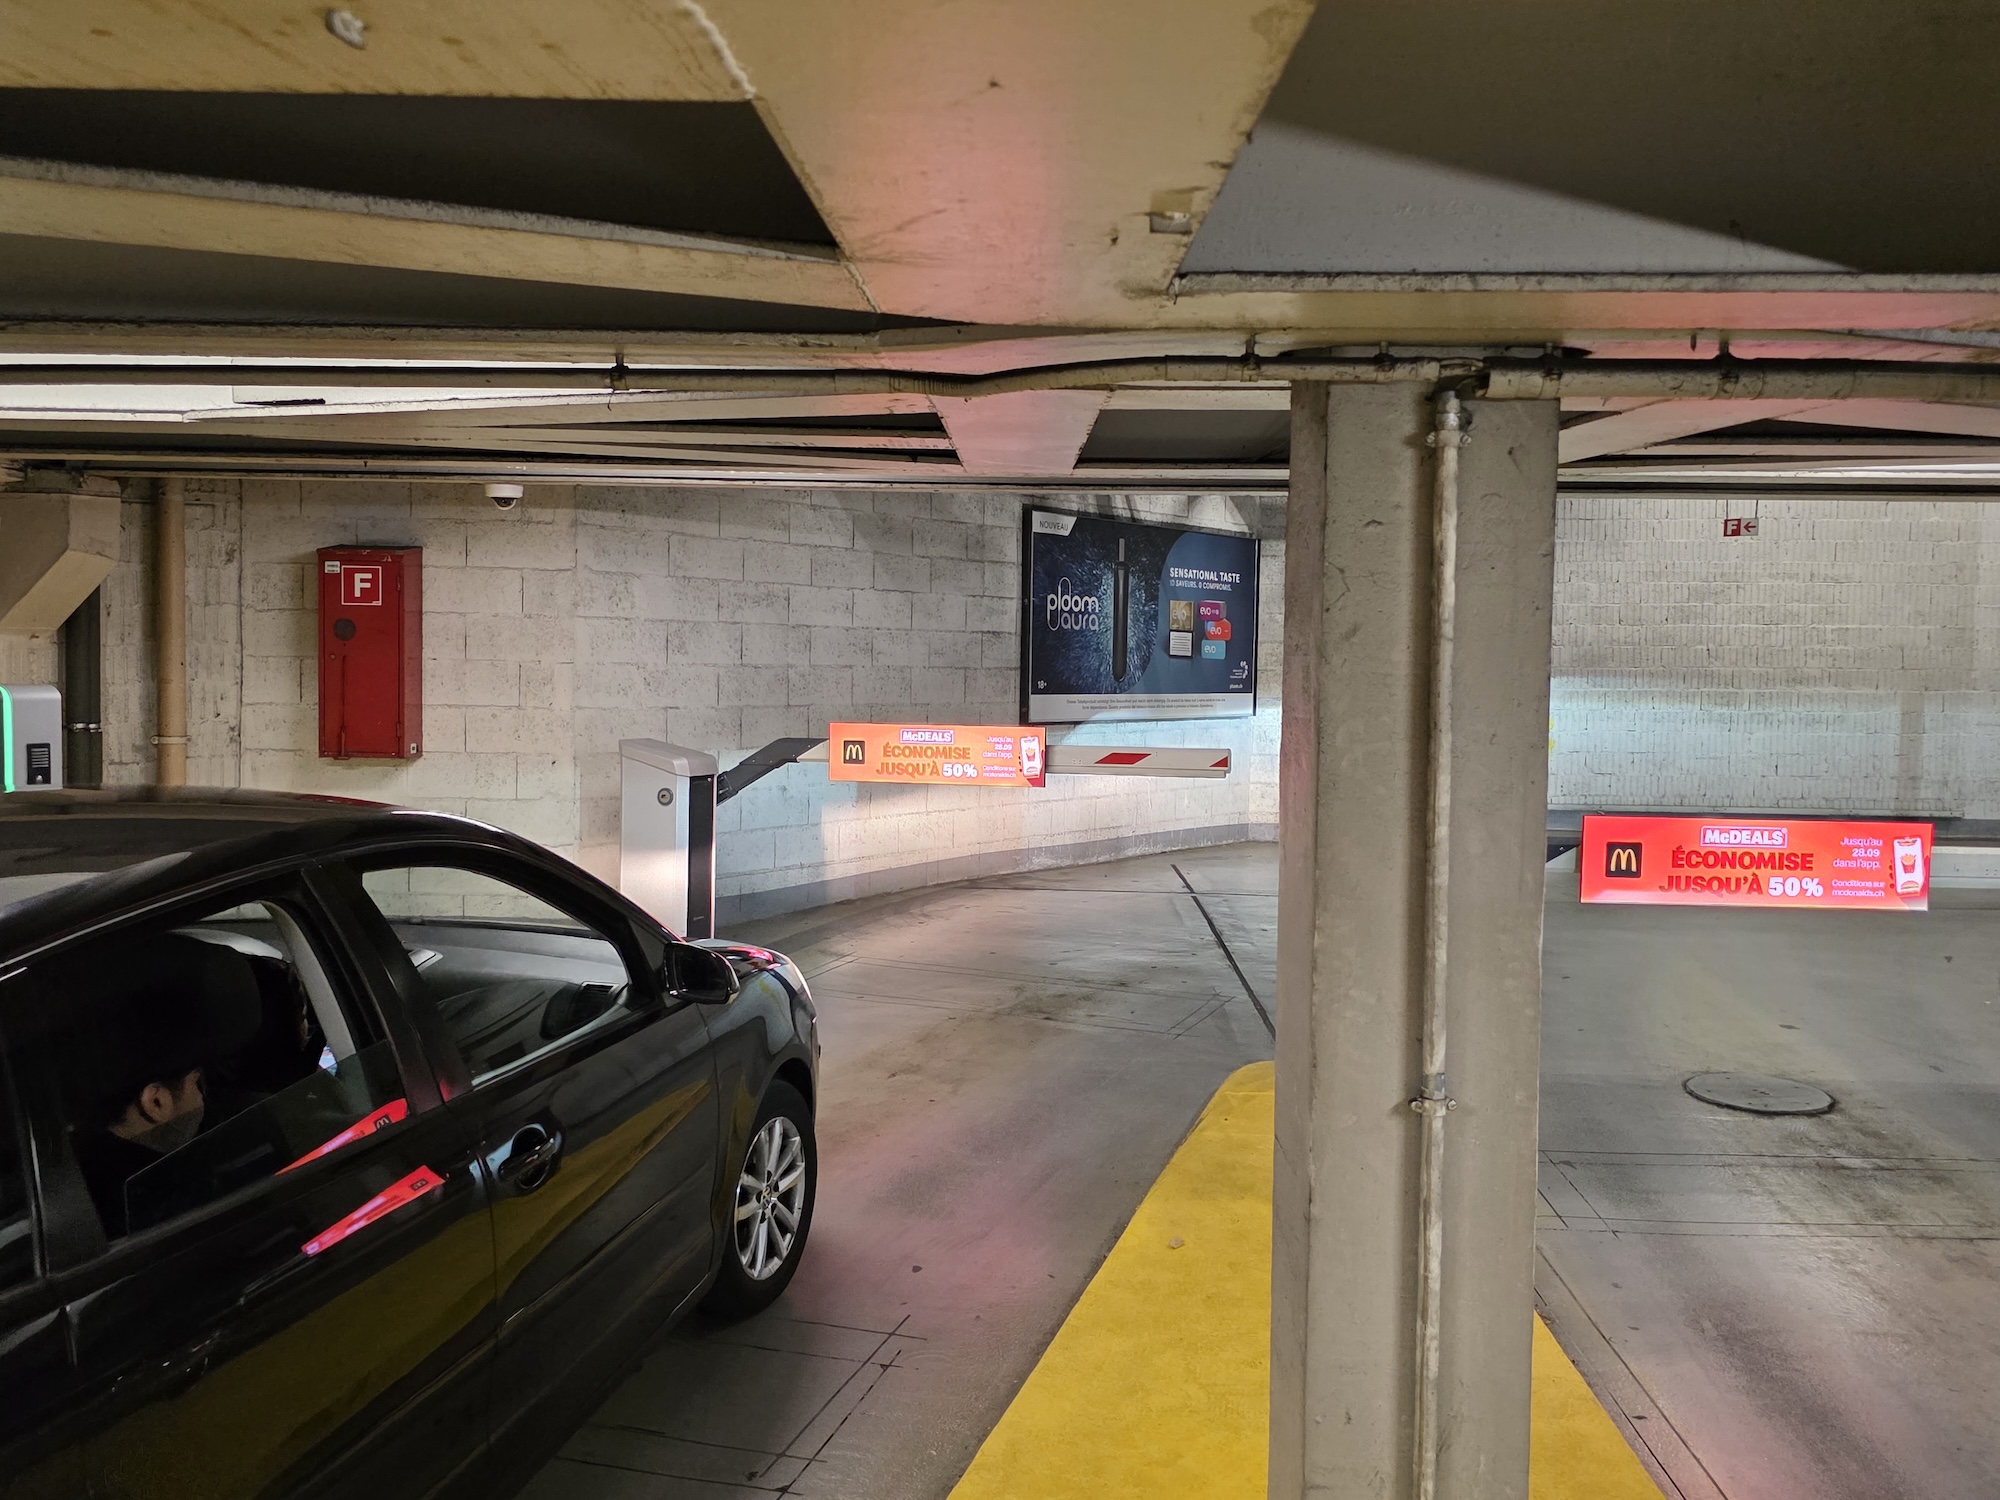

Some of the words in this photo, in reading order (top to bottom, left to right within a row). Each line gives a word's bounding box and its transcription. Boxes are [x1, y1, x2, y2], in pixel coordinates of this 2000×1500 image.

[1039, 520, 1069, 531] NOUVEAU
[1726, 520, 1739, 536] F
[1169, 567, 1219, 581] SENSATIONAL
[1219, 571, 1241, 583] TASTE
[354, 572, 373, 598] F
[1047, 576, 1099, 631] ploom
[1199, 606, 1212, 616] evo
[1060, 612, 1099, 632] aura
[1210, 626, 1222, 636] evo
[1204, 645, 1217, 654] evo
[1037, 680, 1048, 689] 18+
[882, 742, 971, 759] ÉCONOMISE
[875, 760, 941, 778] JUSQU'À
[942, 763, 978, 778] 50%
[1704, 829, 1784, 846] McDEALS
[1840, 837, 1883, 848] Jusqu'au
[1671, 845, 1815, 871] ÉCONOMISE
[1851, 848, 1881, 857] 28.09
[1832, 858, 1856, 868] dans
[1658, 872, 1764, 898] JUSQU'À
[1767, 876, 1824, 897] 50%
[1831, 879, 1873, 888] Conditions
[1831, 889, 1885, 897] mcdonalds.ch
